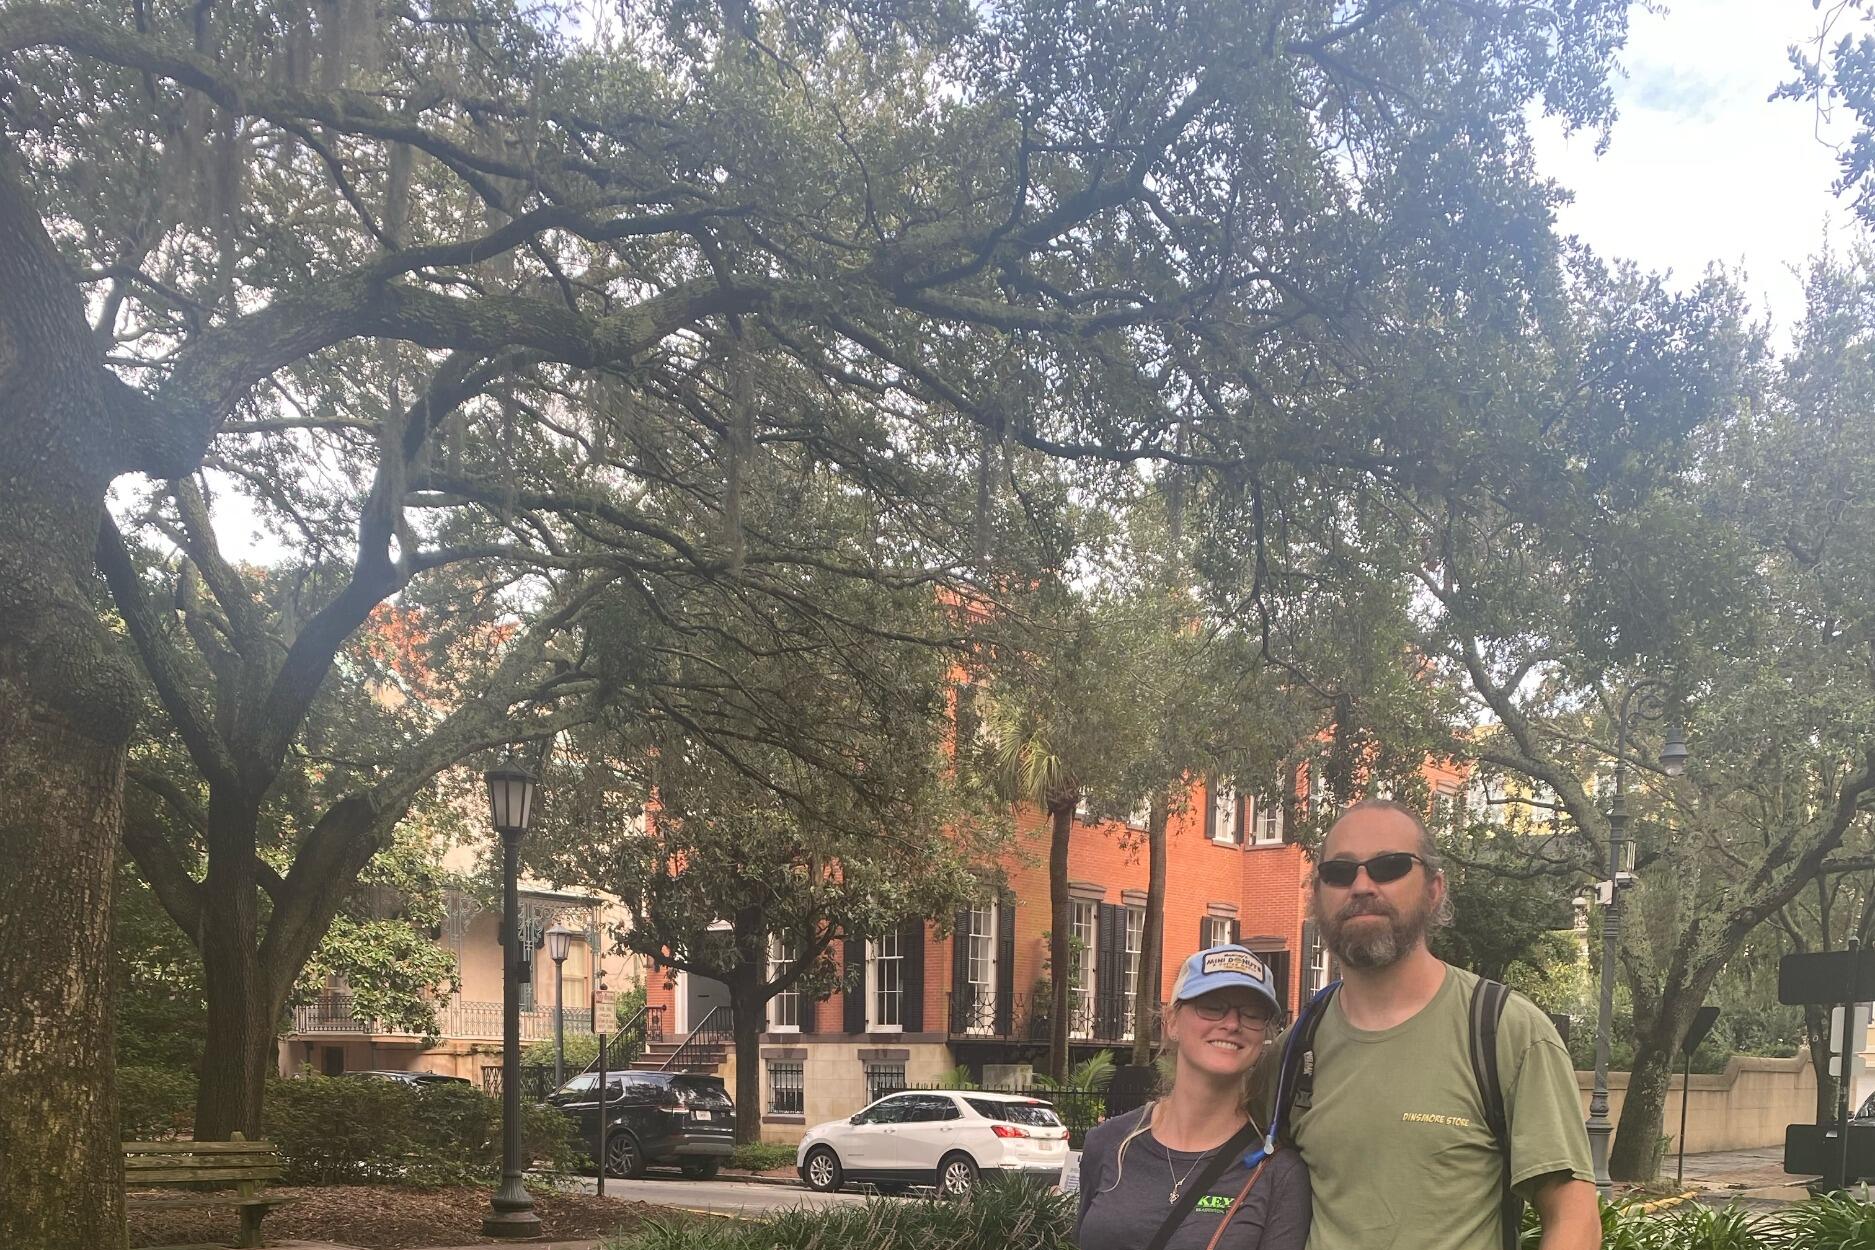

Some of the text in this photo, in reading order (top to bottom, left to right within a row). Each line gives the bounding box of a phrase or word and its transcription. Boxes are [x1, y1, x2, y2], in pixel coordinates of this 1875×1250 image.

[1206, 957, 1226, 966] MINI
[1228, 957, 1262, 973] DONUTS
[1402, 1112, 1470, 1127] DINSMORE STORE
[1197, 1195, 1236, 1208] KEY
